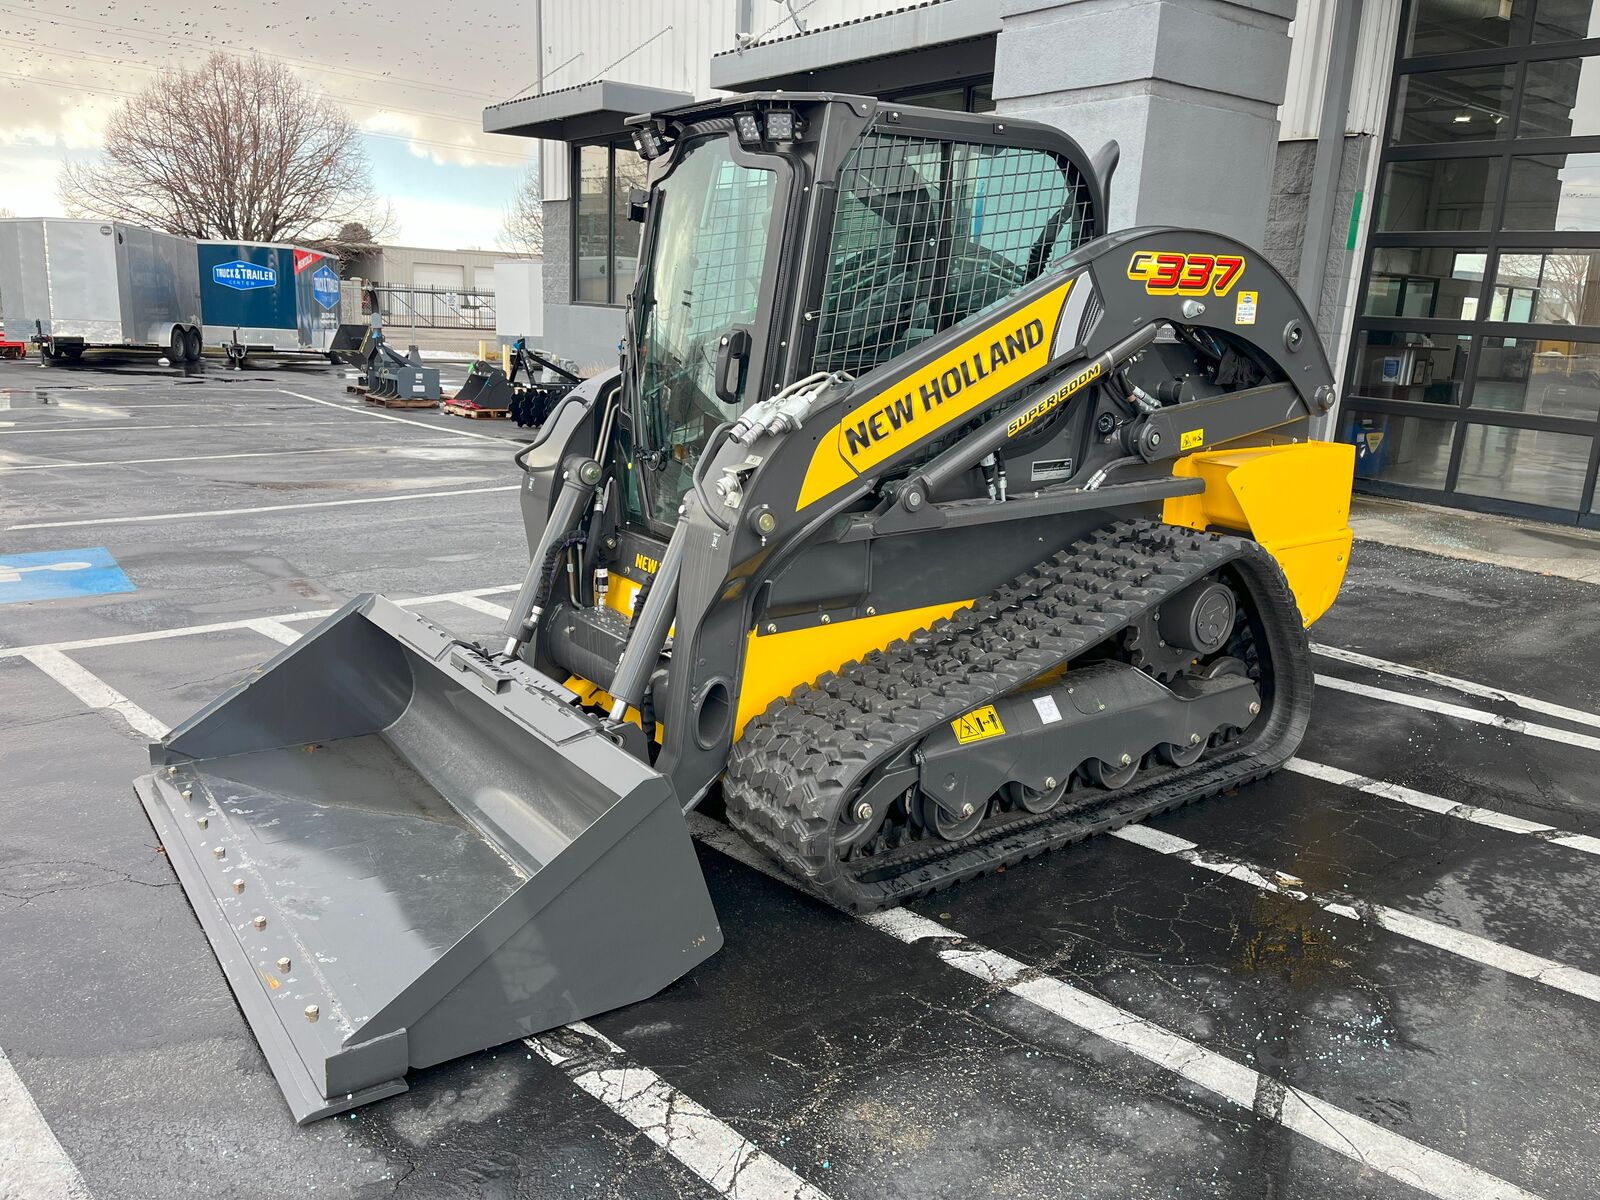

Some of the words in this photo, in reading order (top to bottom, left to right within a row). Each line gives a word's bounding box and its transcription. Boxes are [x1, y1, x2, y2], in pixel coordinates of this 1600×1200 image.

[215, 268, 235, 279] TRUCK
[235, 268, 241, 280] &
[241, 269, 274, 281] TRAILER
[1128, 251, 1245, 294] C337
[844, 392, 914, 457] NEW
[919, 318, 1045, 413] HOLLAND
[1008, 394, 1057, 436] SUPER
[1058, 363, 1100, 401] BOOM
[635, 553, 658, 575] NEW
